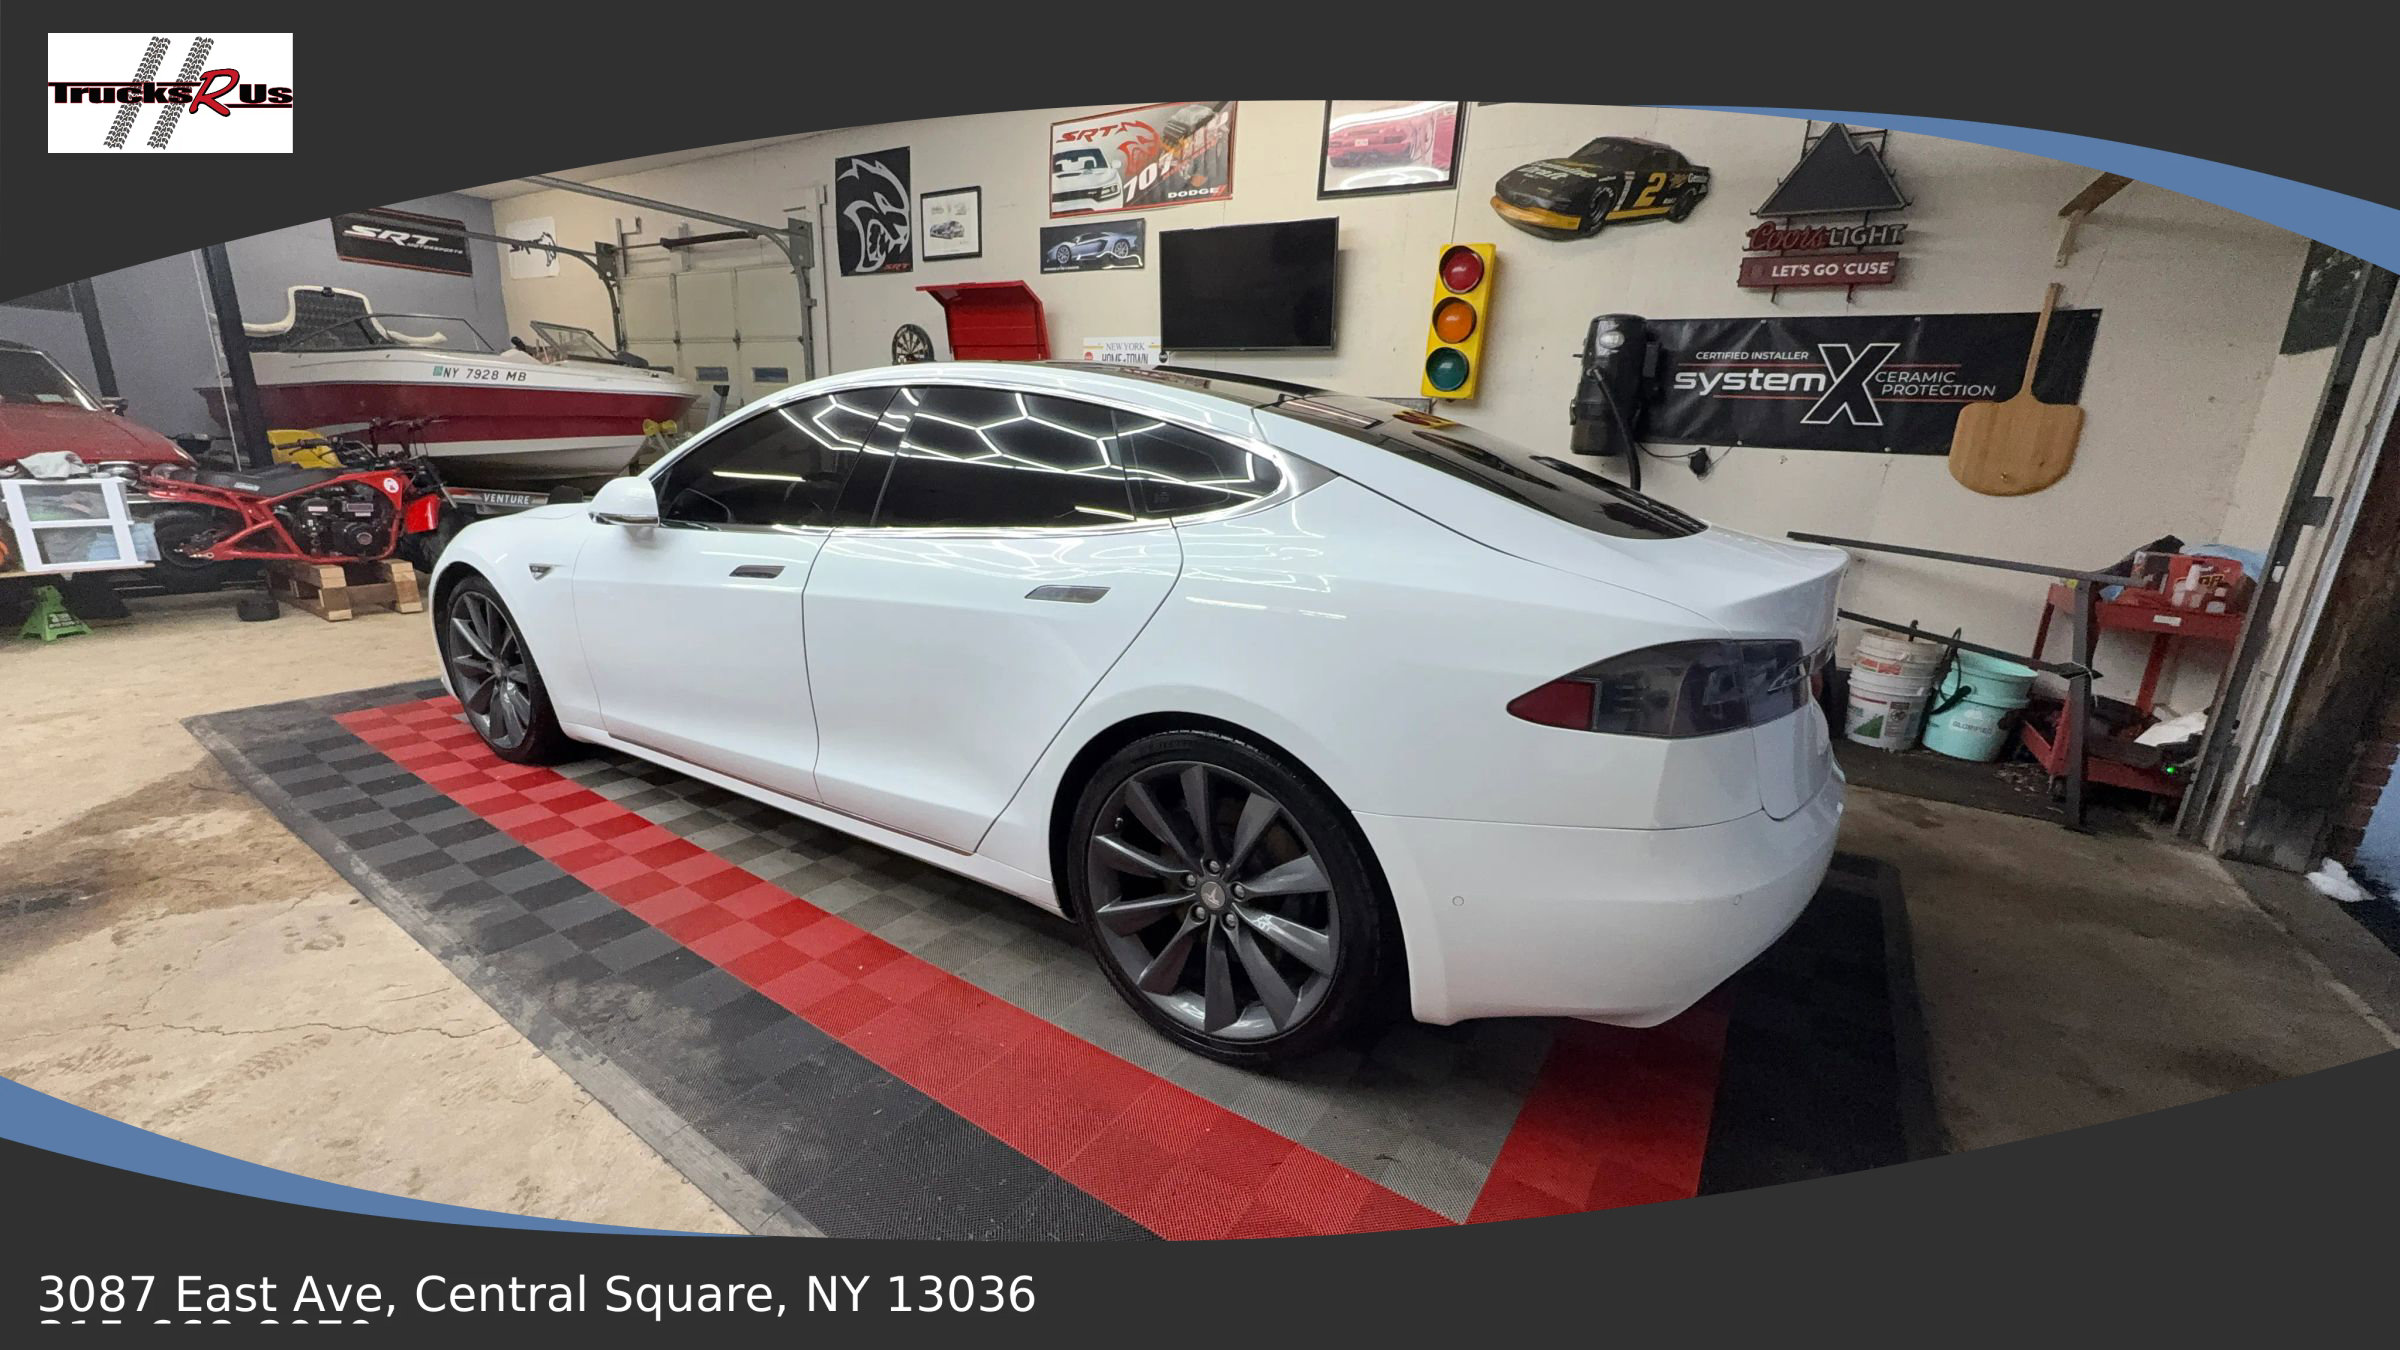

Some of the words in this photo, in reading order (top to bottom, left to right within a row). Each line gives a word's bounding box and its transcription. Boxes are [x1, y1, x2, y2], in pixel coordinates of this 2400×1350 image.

[1056, 124, 1119, 143] SRT
[1168, 186, 1219, 199] DODGE
[1632, 172, 1667, 208] 2
[342, 224, 440, 247] SRT
[1750, 221, 1827, 250] Coors
[1829, 224, 1907, 246] LIGHT
[1771, 264, 1810, 278] LET'S
[1813, 263, 1838, 276] GO
[1843, 261, 1890, 275] 'CUSE
[1105, 342, 1122, 351] NEW
[1122, 342, 1145, 351] YORK
[1695, 351, 1749, 360] CERTIFIED
[1750, 351, 1809, 360] INSTALLER
[442, 367, 459, 379] NY
[465, 368, 499, 380] 7928
[505, 371, 527, 381] MB
[1874, 371, 1956, 384] CERAMIC
[1881, 384, 1996, 397] PROTECTION
[483, 493, 530, 505] VENTURE
